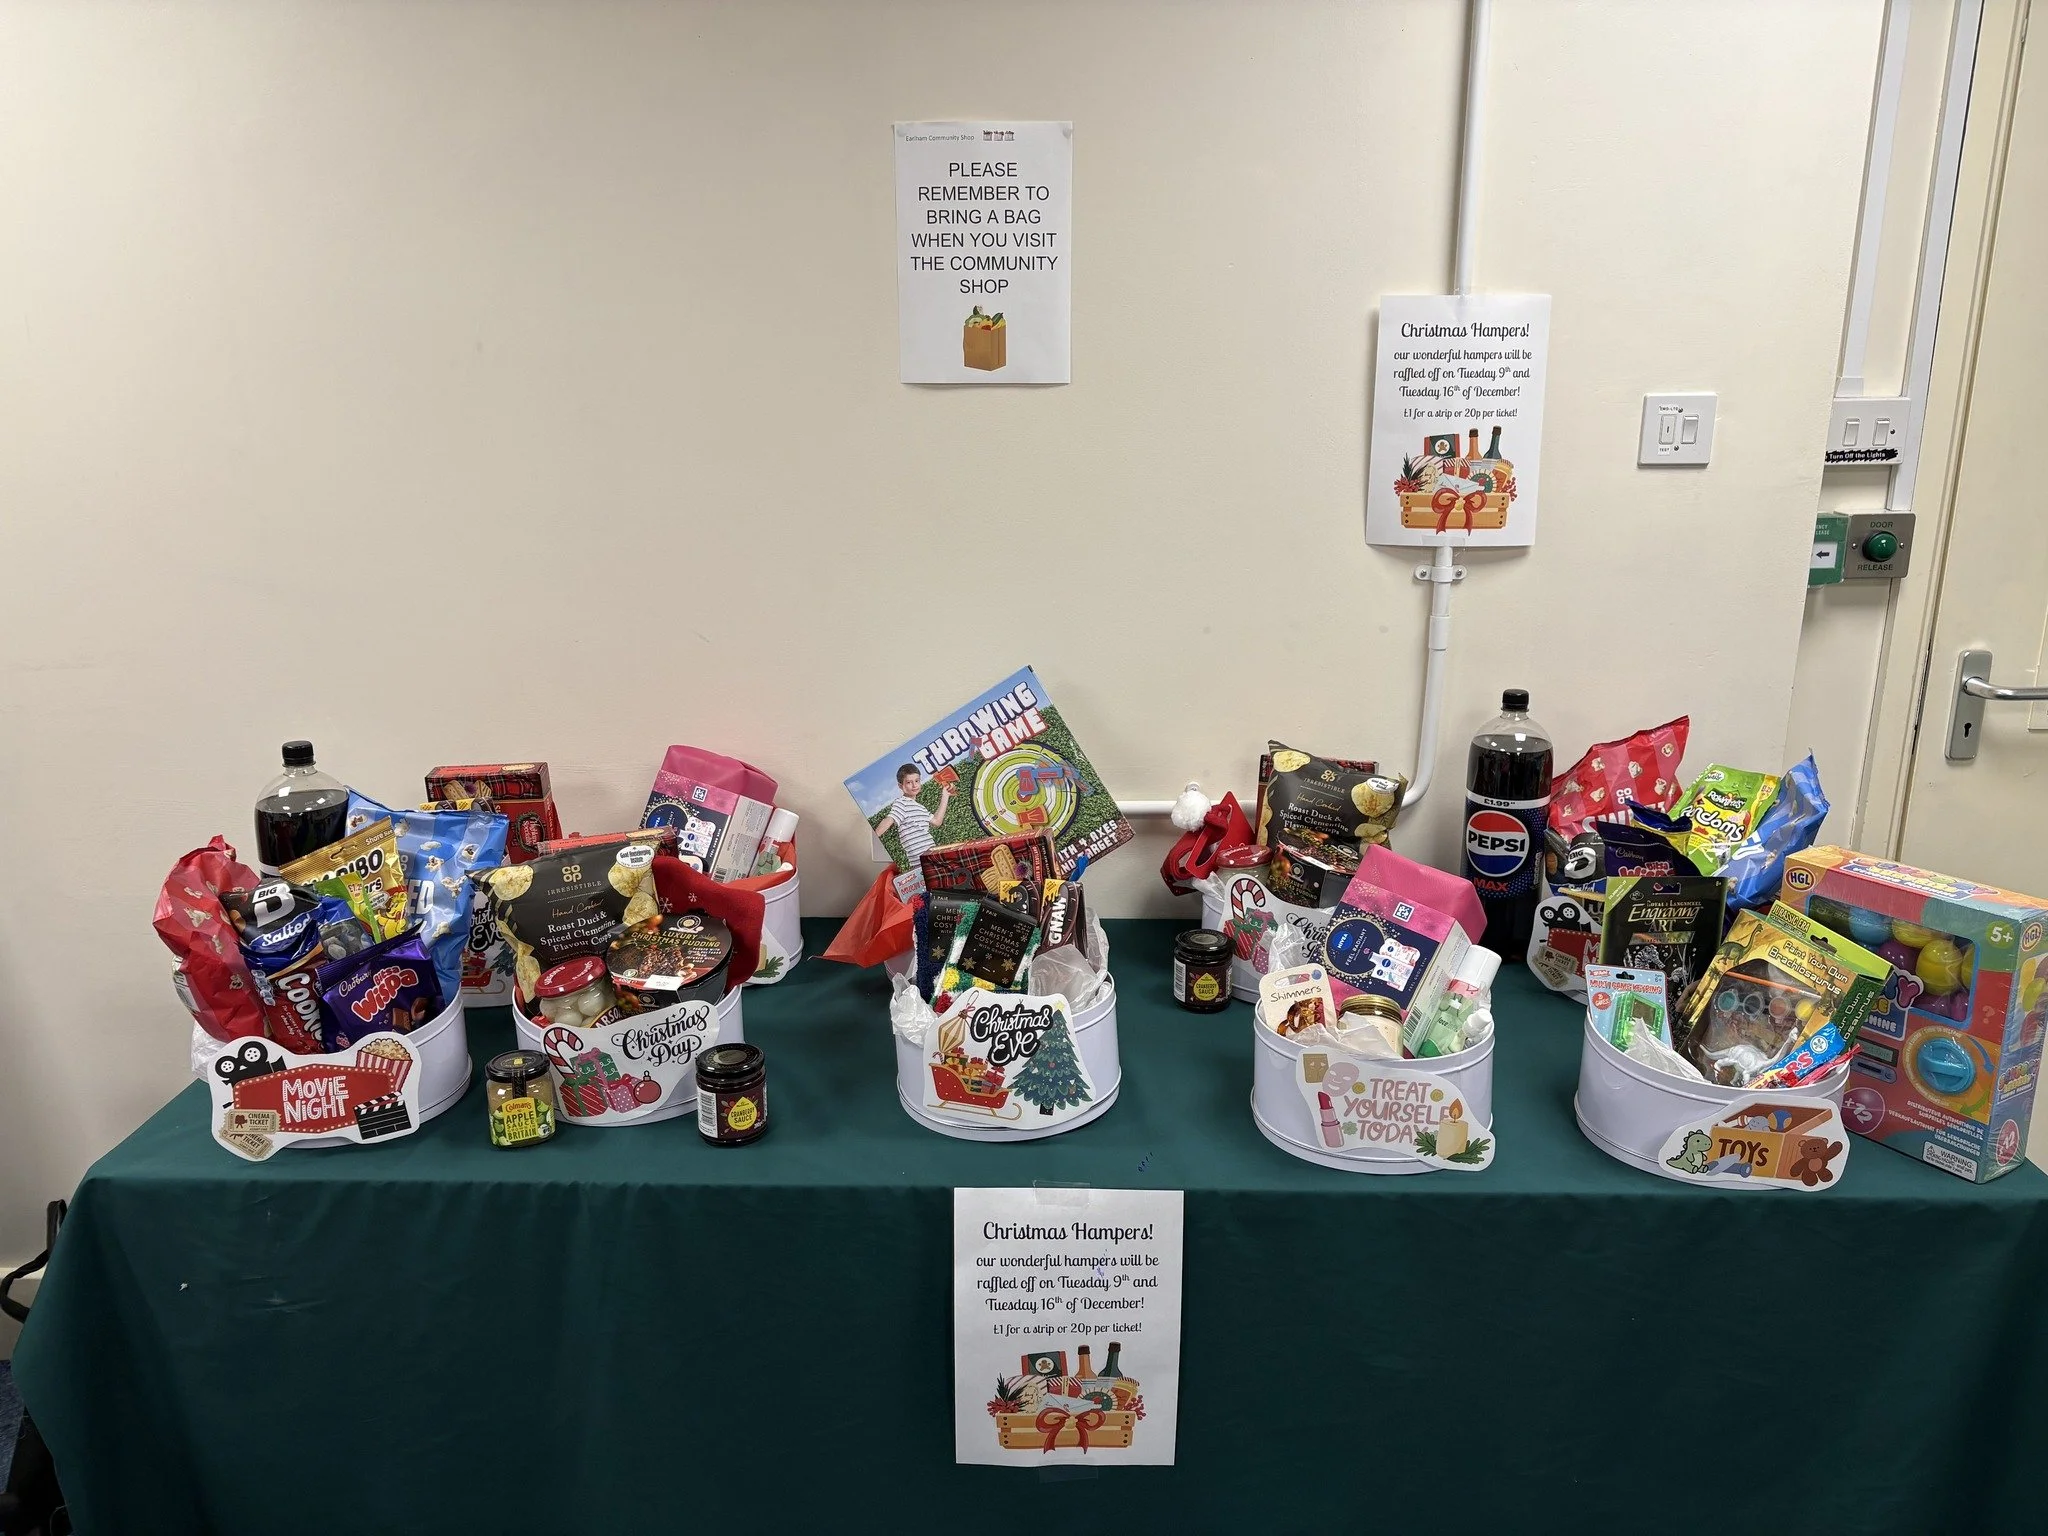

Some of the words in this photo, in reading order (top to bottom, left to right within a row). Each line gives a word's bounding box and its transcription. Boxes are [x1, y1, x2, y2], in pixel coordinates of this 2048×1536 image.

[949, 162, 1017, 178] PLEASE
[918, 185, 1020, 202] REMEMBER
[1025, 186, 1049, 201] TO
[927, 209, 981, 224] BRING
[987, 210, 999, 224] A
[1005, 209, 1042, 224] BAG
[910, 232, 964, 248] WHEN
[969, 232, 1007, 247] YOU
[1012, 233, 1057, 248] VISIT
[910, 256, 944, 271] THE
[949, 256, 1059, 272] COMMUNITY
[960, 278, 1009, 295] SHOP
[1401, 322, 1468, 339] Christmas
[1470, 322, 1529, 342] Hampers!
[1394, 352, 1410, 360] our
[1413, 349, 1462, 363] wonderful
[1463, 350, 1502, 363] hampers
[1505, 349, 1521, 359] will
[1522, 349, 1532, 359] be
[1393, 367, 1426, 382] raffled
[1428, 367, 1441, 381] off
[1457, 367, 1497, 381] Tuesday
[1499, 366, 1511, 378] 9th
[1513, 368, 1531, 378] and
[1398, 385, 1441, 400] Tuesday
[1442, 385, 1461, 398] 16th
[1462, 385, 1473, 400] of
[1473, 386, 1520, 398] December!
[1404, 408, 1412, 417] £1
[1413, 408, 1425, 420] for
[1435, 409, 1452, 420] strip
[1464, 408, 1481, 420] 20p
[1482, 411, 1495, 420] per
[1496, 408, 1517, 417] ticket!
[912, 681, 1038, 774] THROWING
[978, 707, 1048, 760] GAME
[1484, 798, 1510, 807] £1.99
[1280, 809, 1302, 821] Spiced
[1304, 817, 1349, 832] Clementine
[1288, 803, 1309, 815] Roast
[1311, 809, 1333, 821] Duck
[365, 833, 384, 846] Share
[1090, 820, 1118, 841] AXES
[1468, 830, 1526, 852] PEPSI
[1570, 850, 1583, 859] BIG
[547, 880, 602, 895] IRRESISTIBLE
[1473, 877, 1508, 891] MAX
[1790, 872, 1810, 885] HGL
[258, 887, 278, 898] BIG
[552, 905, 574, 918] Hand
[1628, 903, 1700, 924] Engraving
[1773, 905, 1798, 927] JURASSIC
[1797, 918, 1811, 933] ERA
[548, 922, 575, 933] Roast
[578, 912, 600, 926] Duck
[600, 911, 607, 919] &
[990, 924, 1013, 937] MEN'S
[1648, 920, 1676, 932] ART
[540, 935, 572, 946] Spiced
[573, 920, 616, 938] Clementine
[631, 932, 680, 945] CHRISTMAS
[662, 931, 697, 939] LUXURY
[979, 928, 1019, 948] CHRISTMAS
[1337, 933, 1348, 948] NIVEA
[1990, 927, 2013, 943] 5+
[2024, 928, 2040, 946] HGL
[553, 940, 589, 952] Flavour
[974, 934, 993, 945] COSY
[995, 942, 1019, 956] SOCKS
[1346, 952, 1355, 966] FEEL
[1354, 928, 1367, 952] RADIANT
[1769, 947, 1842, 995] Brachiosaurus
[1784, 941, 1806, 959] Paint
[1808, 953, 1828, 970] Your
[1828, 966, 1848, 983] Own
[339, 970, 372, 997] Cadbury
[1590, 980, 1611, 989] MULTI
[351, 969, 418, 1022] Wispa
[1270, 985, 1322, 1003] Shimmers
[1845, 992, 1862, 1014] Own
[611, 1005, 709, 1060] Christmas
[973, 1006, 1050, 1041] Christmas
[651, 1034, 702, 1067] Day
[990, 1032, 1038, 1063] Eve
[1370, 1078, 1431, 1103] TREAT
[505, 1102, 532, 1113] Colman's
[1344, 1095, 1450, 1125] YOURSELF
[1907, 1100, 1941, 1117] DISTRIBUTEUR
[1943, 1114, 1976, 1131] AUTOMATIQUE
[506, 1111, 534, 1124] APPLE
[734, 1114, 752, 1123] SAUCE
[508, 1128, 537, 1140] BRITAIN
[1358, 1120, 1429, 1146] TODAY
[1947, 1122, 1983, 1140] SENSORIELLES
[1719, 1138, 1769, 1166] TOYS
[983, 1221, 1068, 1240] Christmas
[1071, 1222, 1153, 1245] Hampers!
[976, 1257, 996, 1267] our
[1000, 1254, 1063, 1271] wonderful
[1064, 1254, 1118, 1270] hampers
[1120, 1254, 1143, 1266] will
[1145, 1254, 1160, 1267] be
[977, 1276, 1019, 1294] raffled
[1020, 1276, 1040, 1293] off
[1039, 1280, 1056, 1288] on
[1057, 1276, 1111, 1292] Tuesday
[1113, 1273, 1130, 1288] 9th
[1133, 1276, 1158, 1287] and
[985, 1298, 1038, 1314] Tuesday
[1040, 1296, 1064, 1311] 16th
[1066, 1297, 1079, 1313] of
[1080, 1297, 1144, 1311] December!
[992, 1324, 1003, 1334] £1
[1004, 1324, 1020, 1337] for
[1023, 1327, 1032, 1335] a
[1032, 1324, 1054, 1336] strip
[1057, 1325, 1069, 1334] or
[1071, 1323, 1091, 1336] 20p
[1094, 1325, 1110, 1335] per
[1113, 1322, 1141, 1333] ticket!
